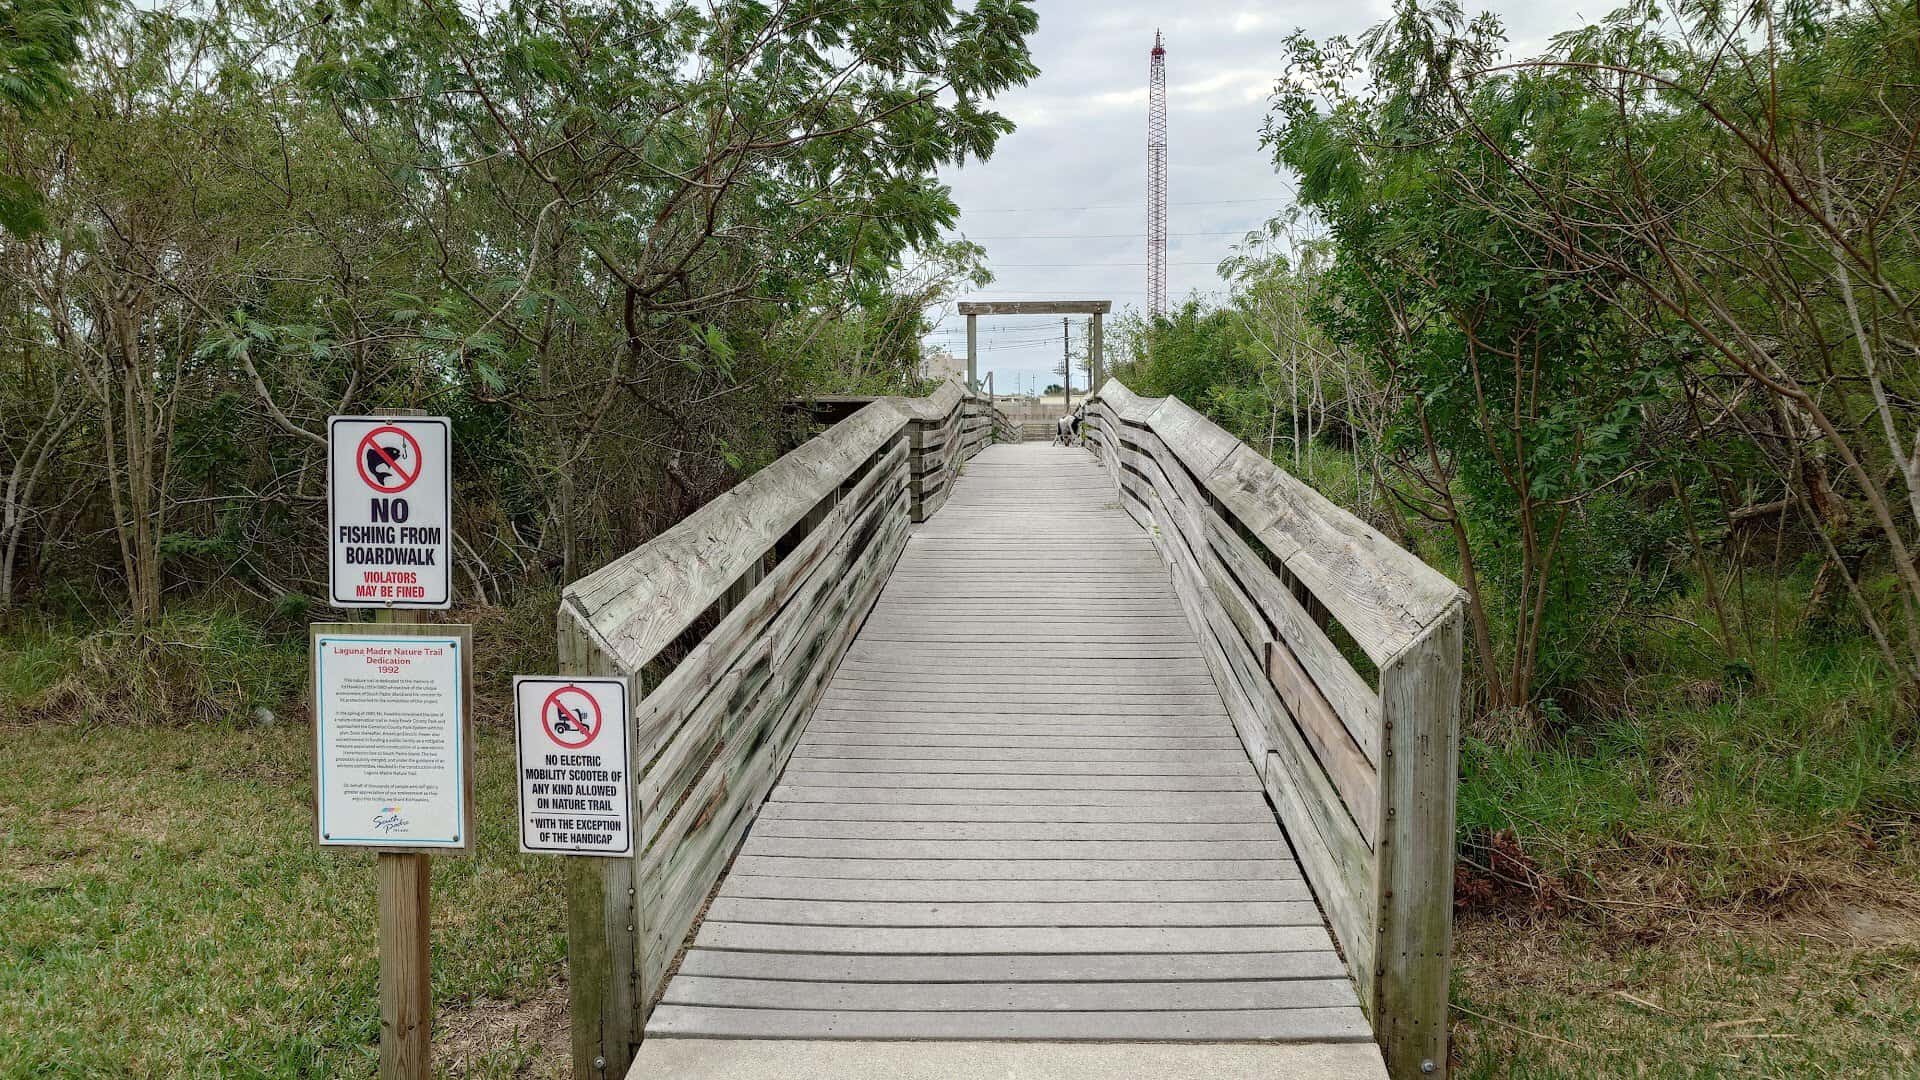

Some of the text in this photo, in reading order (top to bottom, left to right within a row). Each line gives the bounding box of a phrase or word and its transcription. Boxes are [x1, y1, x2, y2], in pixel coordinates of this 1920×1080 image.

[371, 498, 408, 523] NO
[340, 526, 440, 545] FISHING FROM
[346, 547, 435, 566] BOARDWALK
[364, 572, 417, 583] VIOLATORS
[356, 585, 424, 598] MAY BE FINED
[334, 647, 443, 657] Laguna Madre Nature Trail
[367, 656, 411, 665] Dedication
[379, 666, 400, 674] 1992
[546, 755, 601, 766] NO ELECTRIC
[526, 770, 622, 782] MOBILITY SCOOTER OF
[532, 784, 616, 796] ANY KIND ALLOWED
[538, 799, 613, 811] ON NATURE TRAIL
[536, 819, 621, 831] WITH THE EXCEPTION
[540, 832, 612, 844] OF THE HANDICAP
